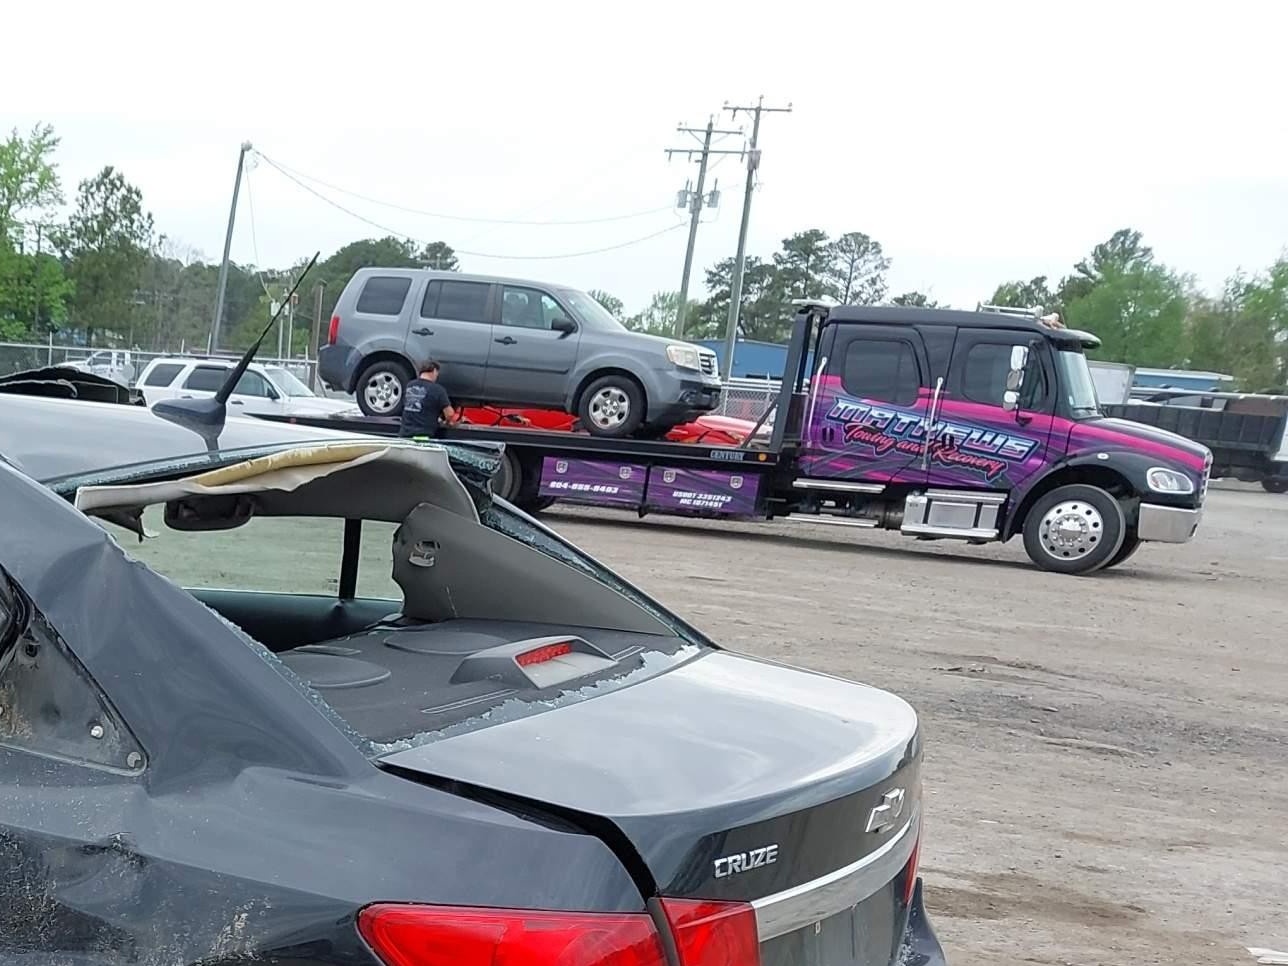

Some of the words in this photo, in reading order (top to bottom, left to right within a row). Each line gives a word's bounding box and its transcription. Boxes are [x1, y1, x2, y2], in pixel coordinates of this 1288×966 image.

[828, 399, 1037, 460] MATHEWS
[845, 422, 895, 451] Towing
[931, 441, 1006, 477] Recovery
[710, 450, 745, 461] CENTURY
[714, 844, 778, 878] CRUZE
